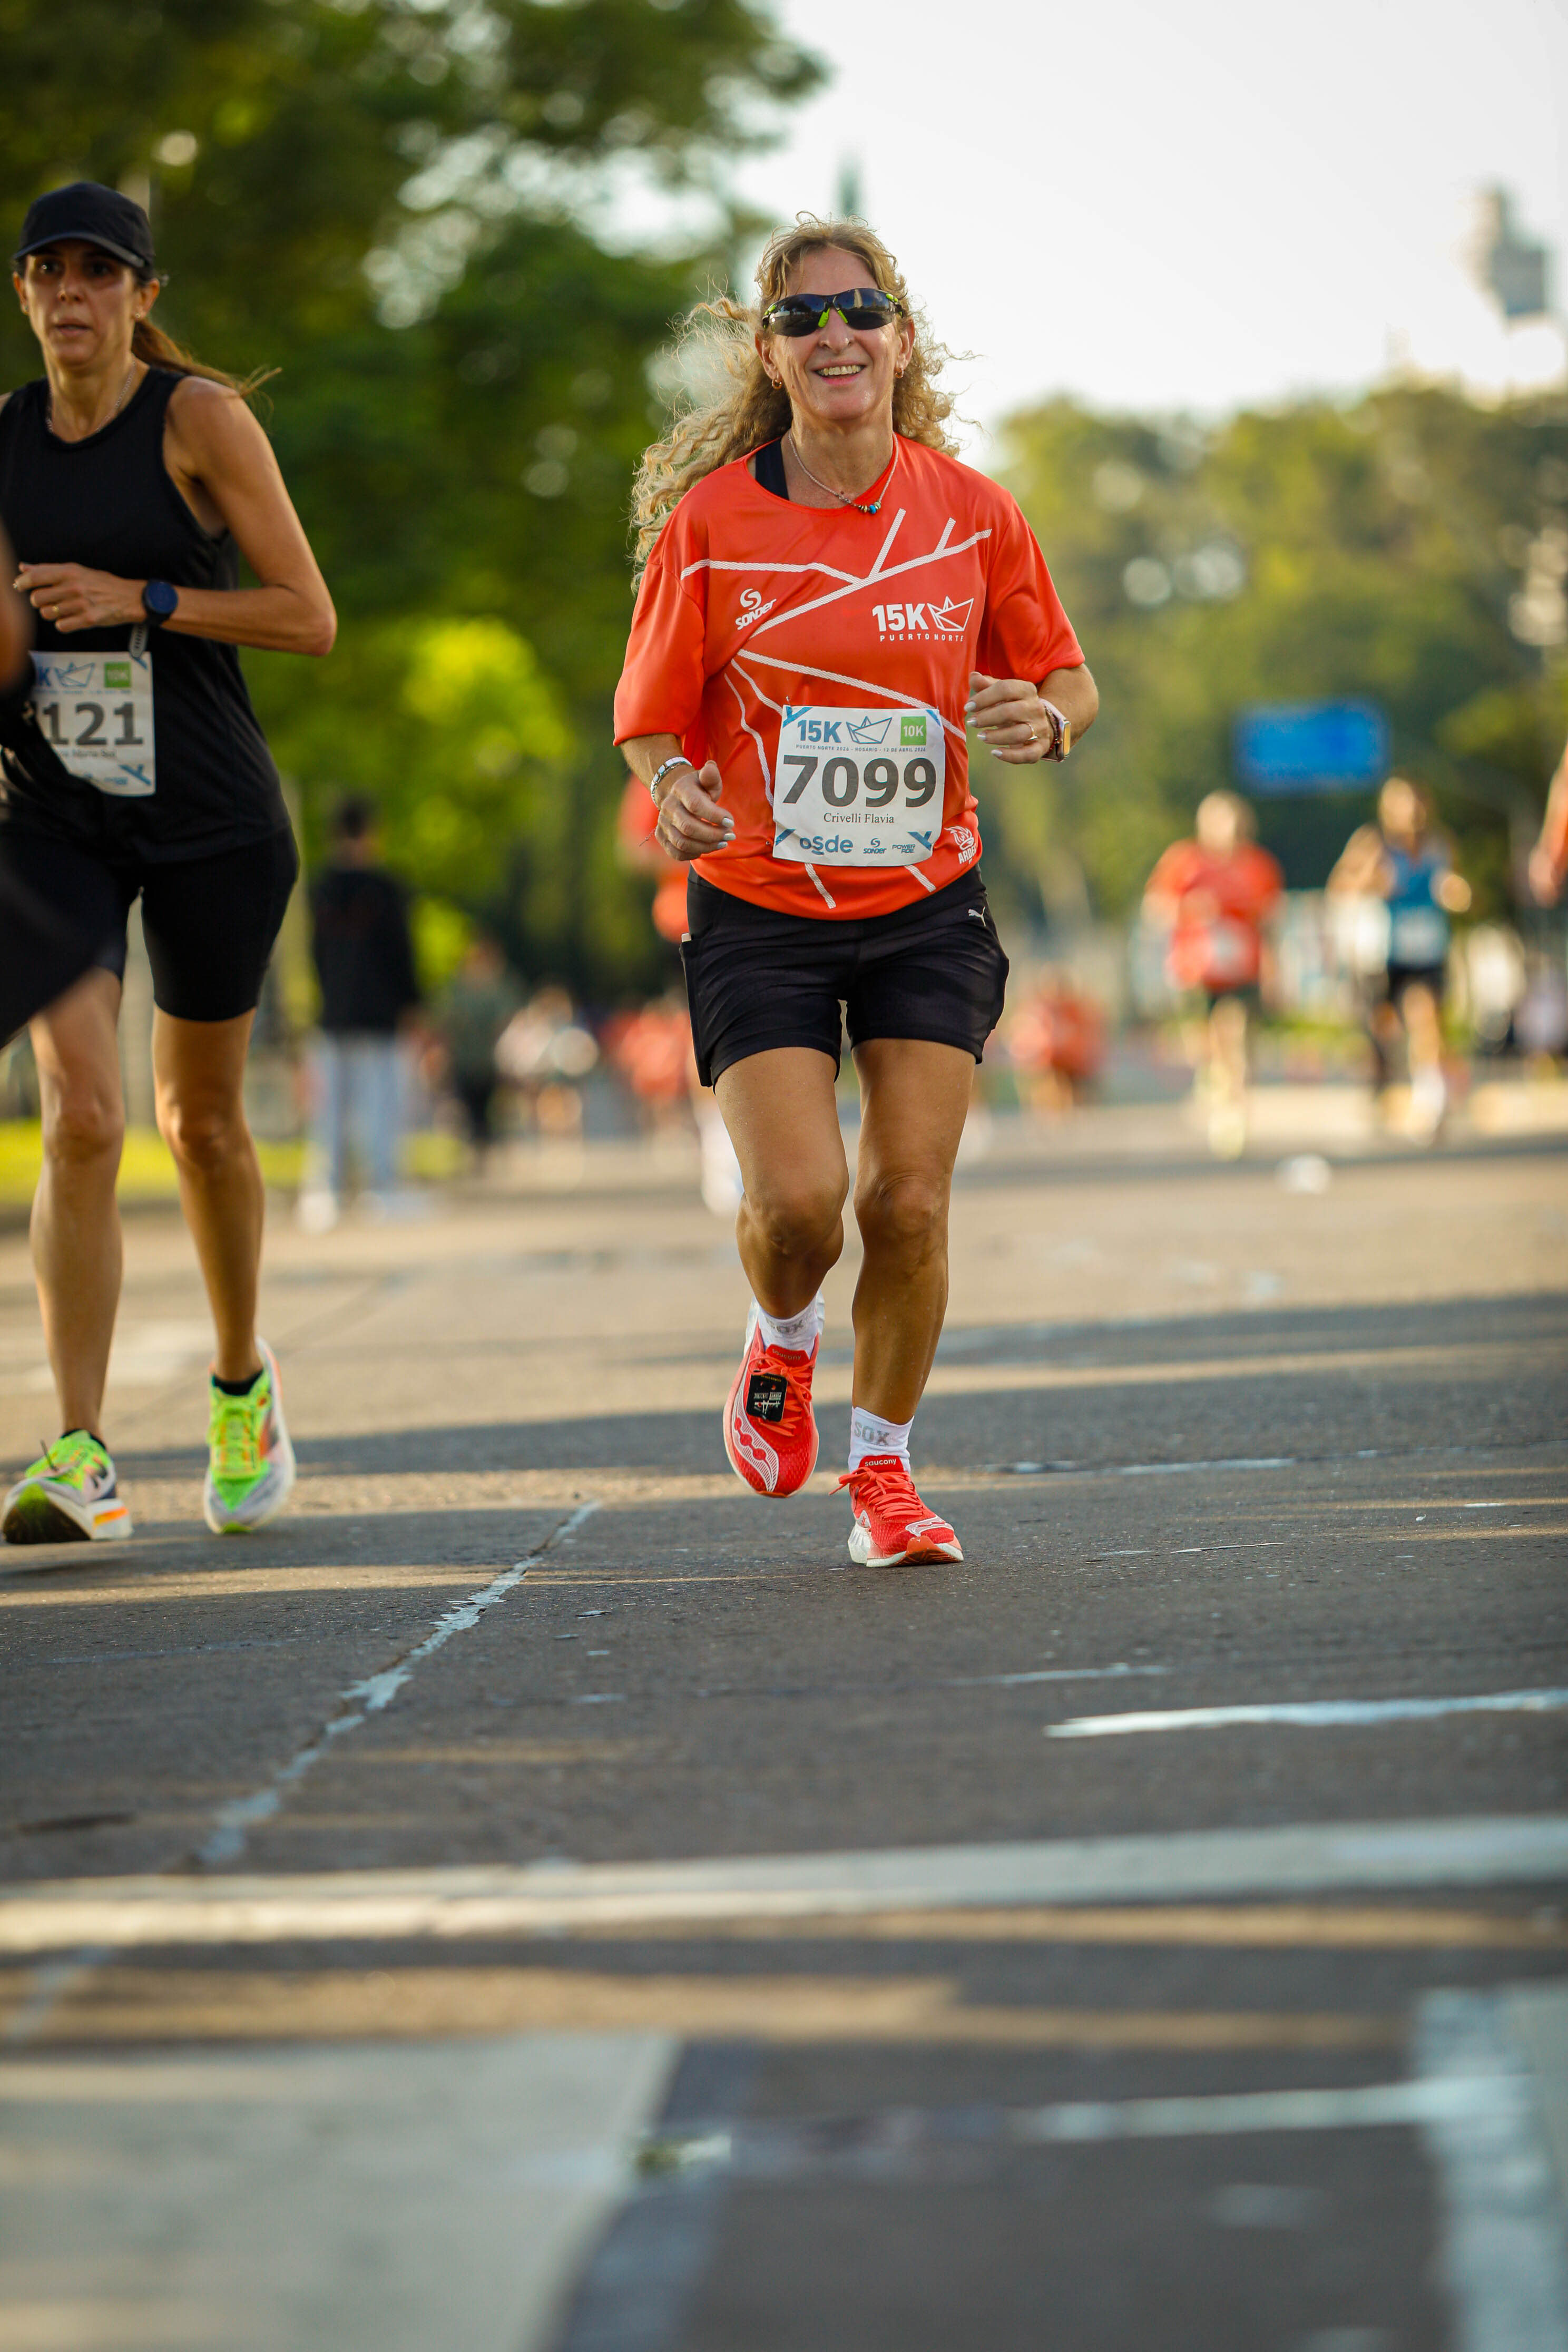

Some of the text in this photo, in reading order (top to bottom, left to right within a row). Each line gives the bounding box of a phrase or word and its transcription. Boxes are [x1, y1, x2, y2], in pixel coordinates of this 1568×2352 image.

[872, 603, 929, 632] 15K
[880, 633, 929, 642] PUERTO
[30, 701, 143, 746] 121
[797, 720, 842, 743] 15K
[903, 725, 924, 737] 10K
[782, 755, 937, 808] 7099
[824, 812, 895, 824] Crivelli Flavia
[799, 835, 854, 855] osde
[865, 1458, 896, 1467] saucony
